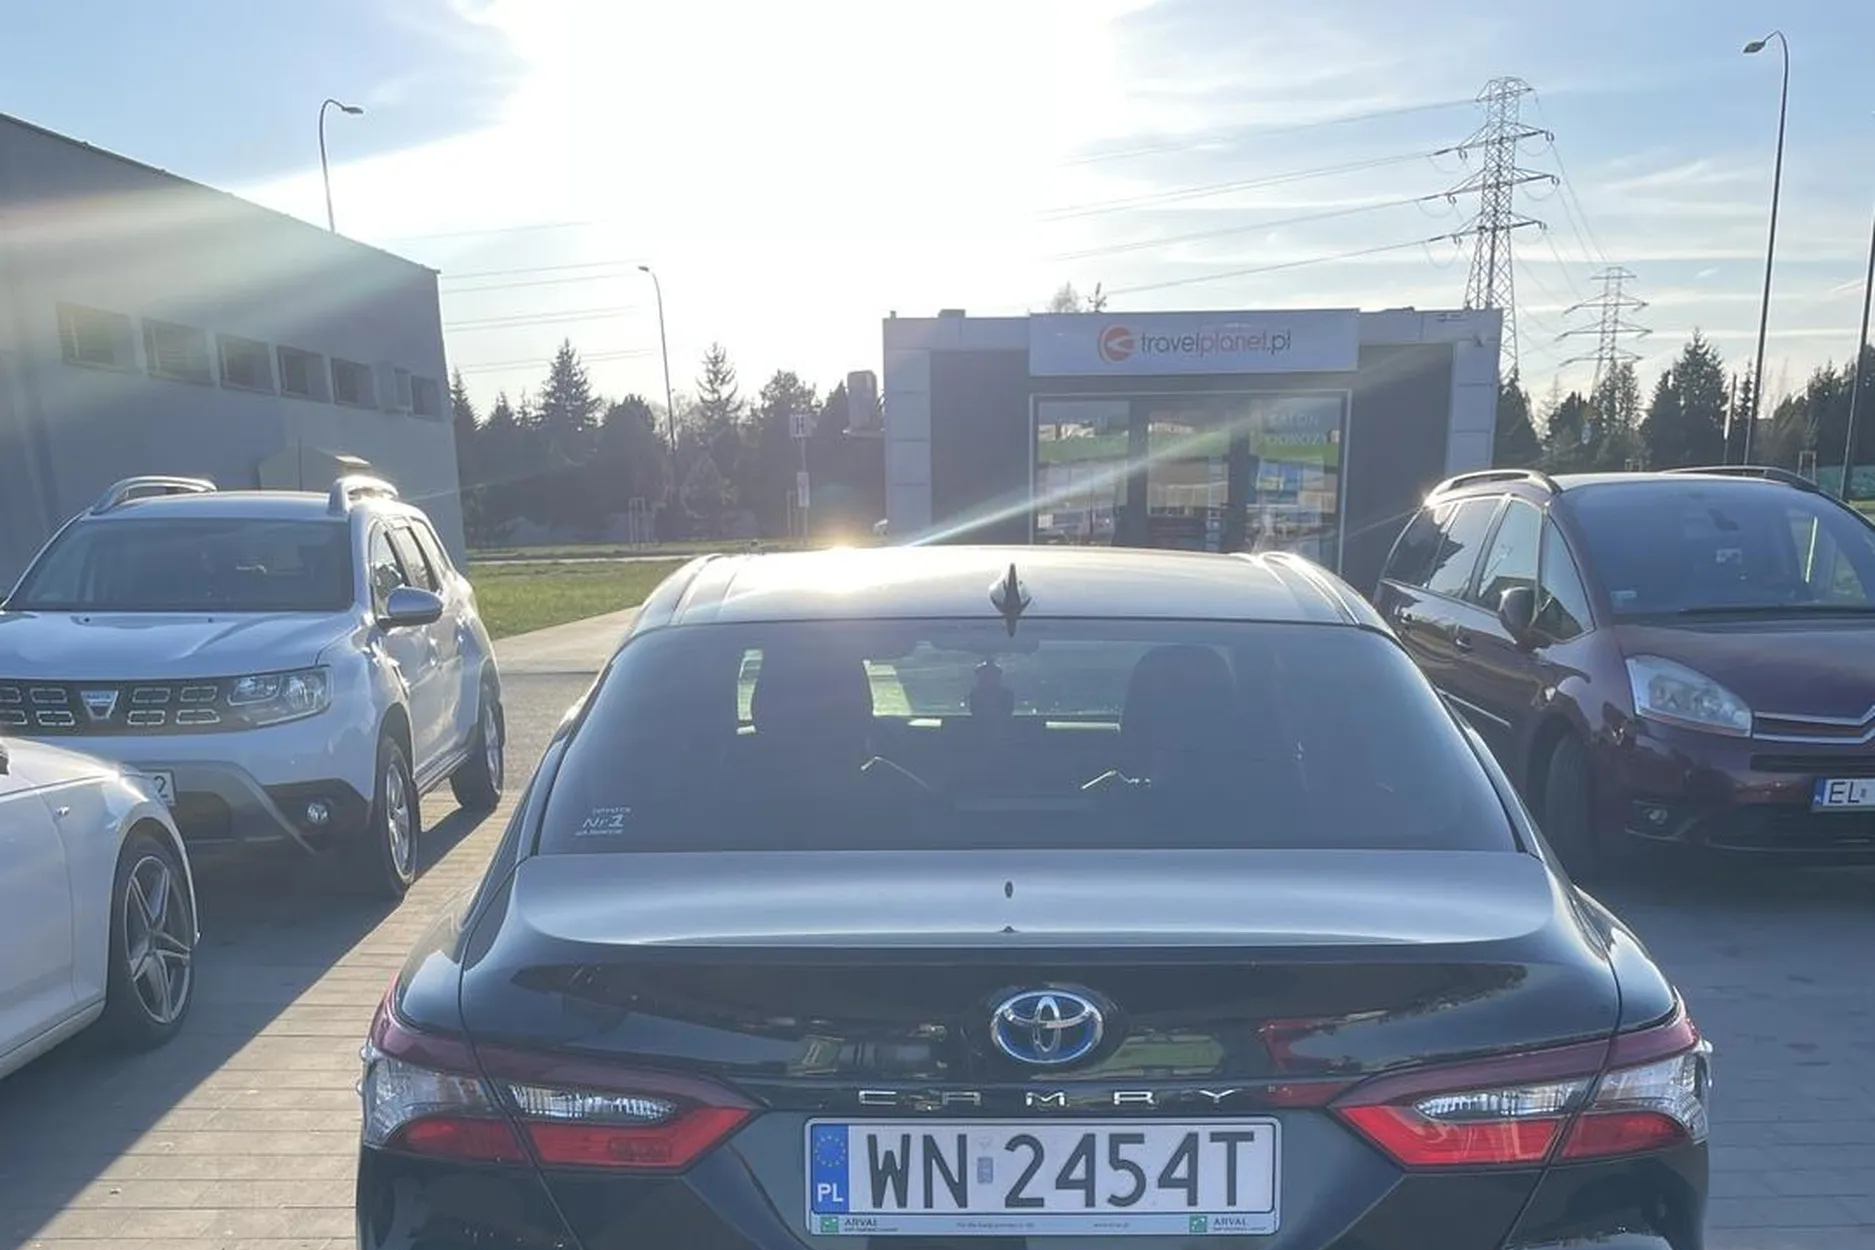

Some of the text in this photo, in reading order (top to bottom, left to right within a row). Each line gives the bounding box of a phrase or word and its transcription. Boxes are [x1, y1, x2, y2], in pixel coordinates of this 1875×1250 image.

[1140, 329, 1292, 356] travelplanet.pl
[1829, 782, 1859, 804] EL
[857, 1088, 1237, 1107] CAMRY
[866, 1130, 1256, 1209] WN 2454T
[817, 1183, 844, 1202] PL
